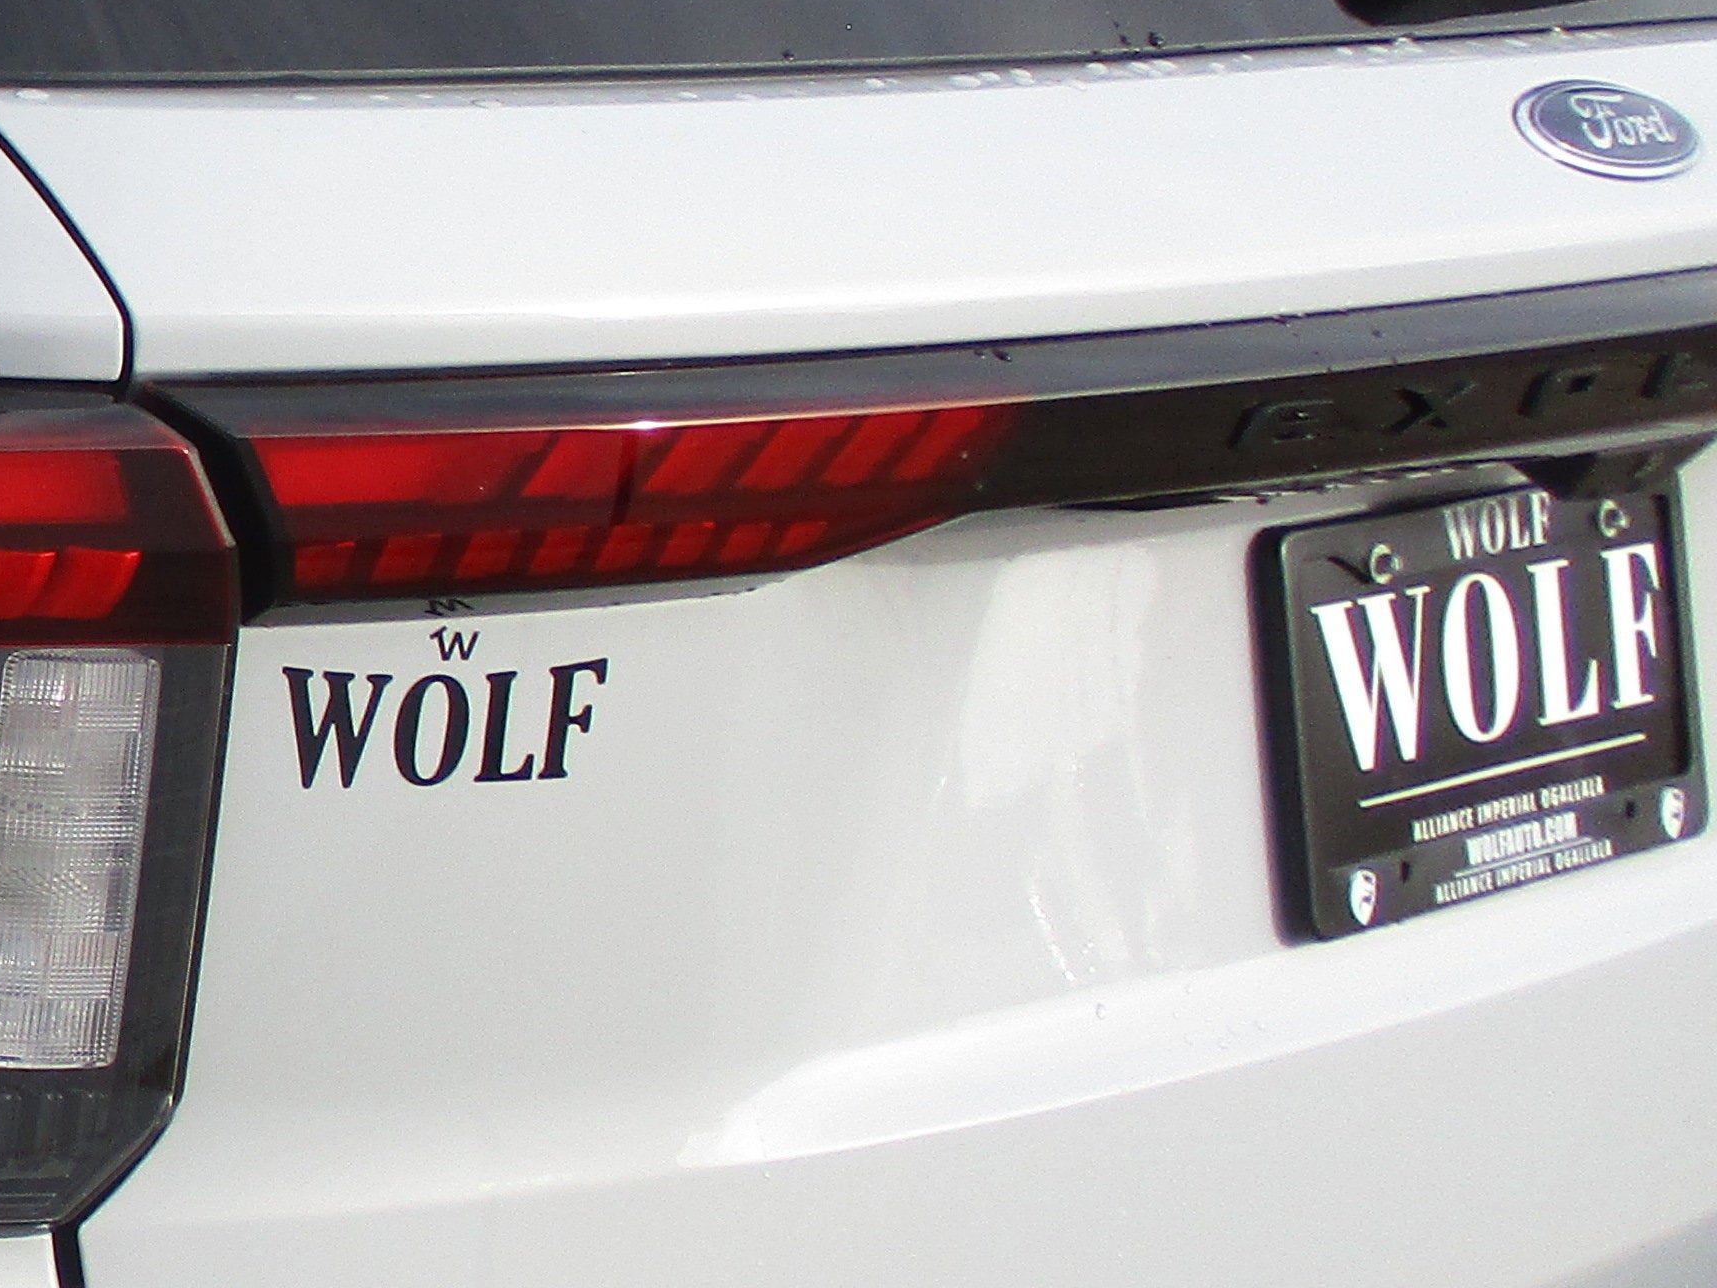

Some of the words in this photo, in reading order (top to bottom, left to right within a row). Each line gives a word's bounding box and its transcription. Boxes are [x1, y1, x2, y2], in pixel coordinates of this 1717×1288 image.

[1568, 94, 1678, 150] Ford
[1444, 490, 1550, 561] WOLF
[1310, 542, 1663, 772] WOLF
[281, 657, 609, 789] WOLF
